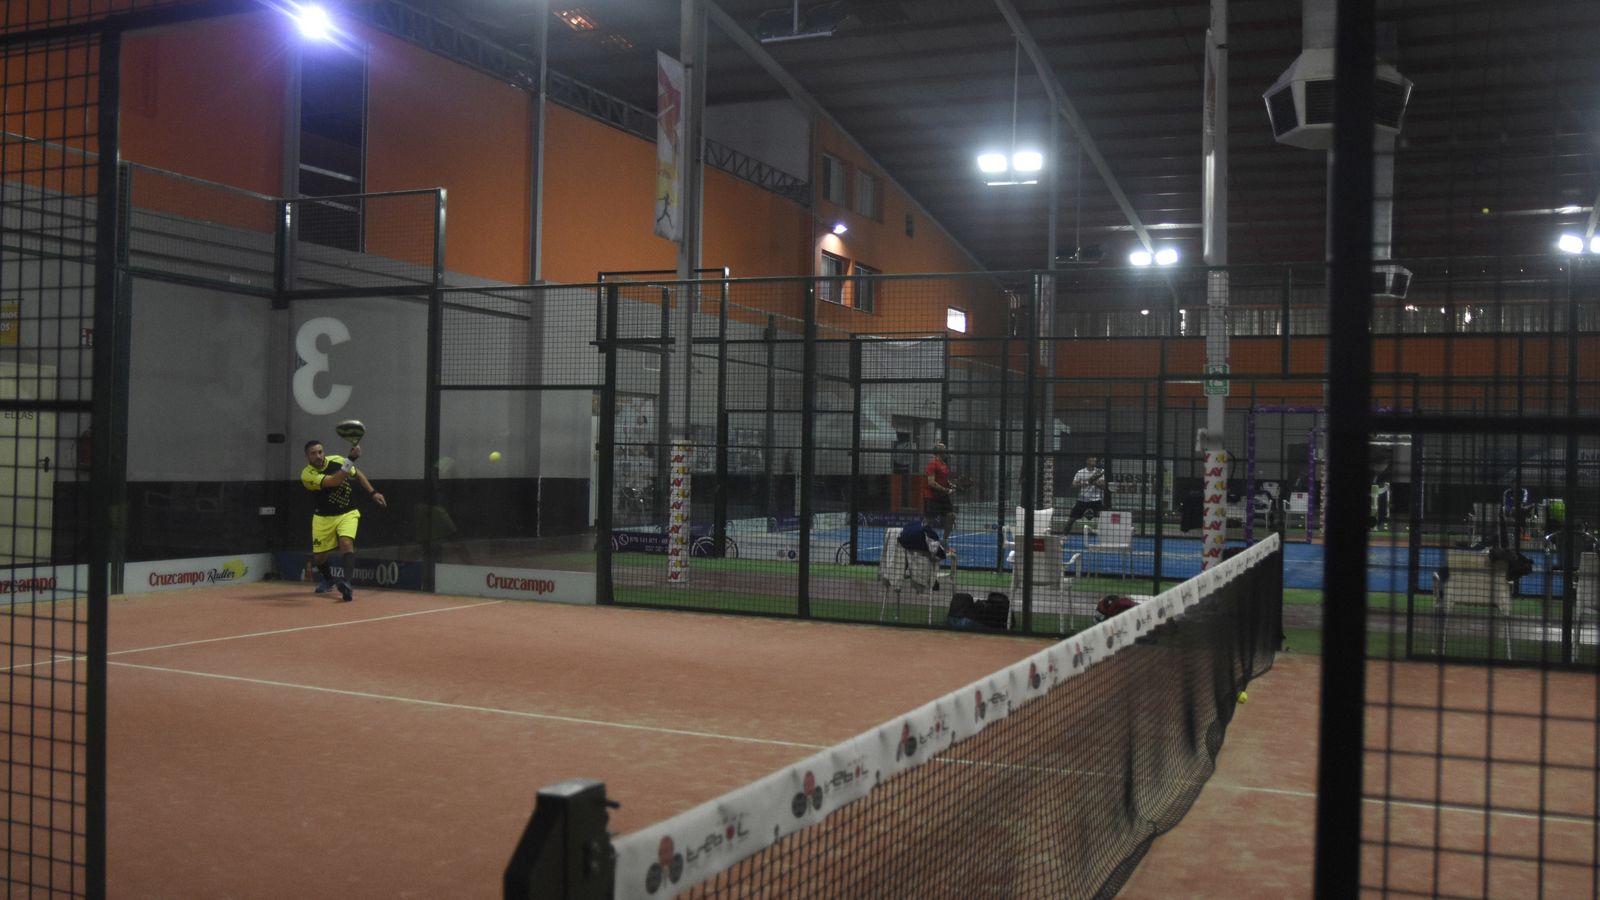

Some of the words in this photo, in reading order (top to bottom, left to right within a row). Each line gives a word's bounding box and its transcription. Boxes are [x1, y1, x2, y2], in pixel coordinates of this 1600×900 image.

[149, 571, 205, 586] Cruzcampo
[207, 568, 236, 583] Radler
[486, 573, 555, 595] Cruzcampo
